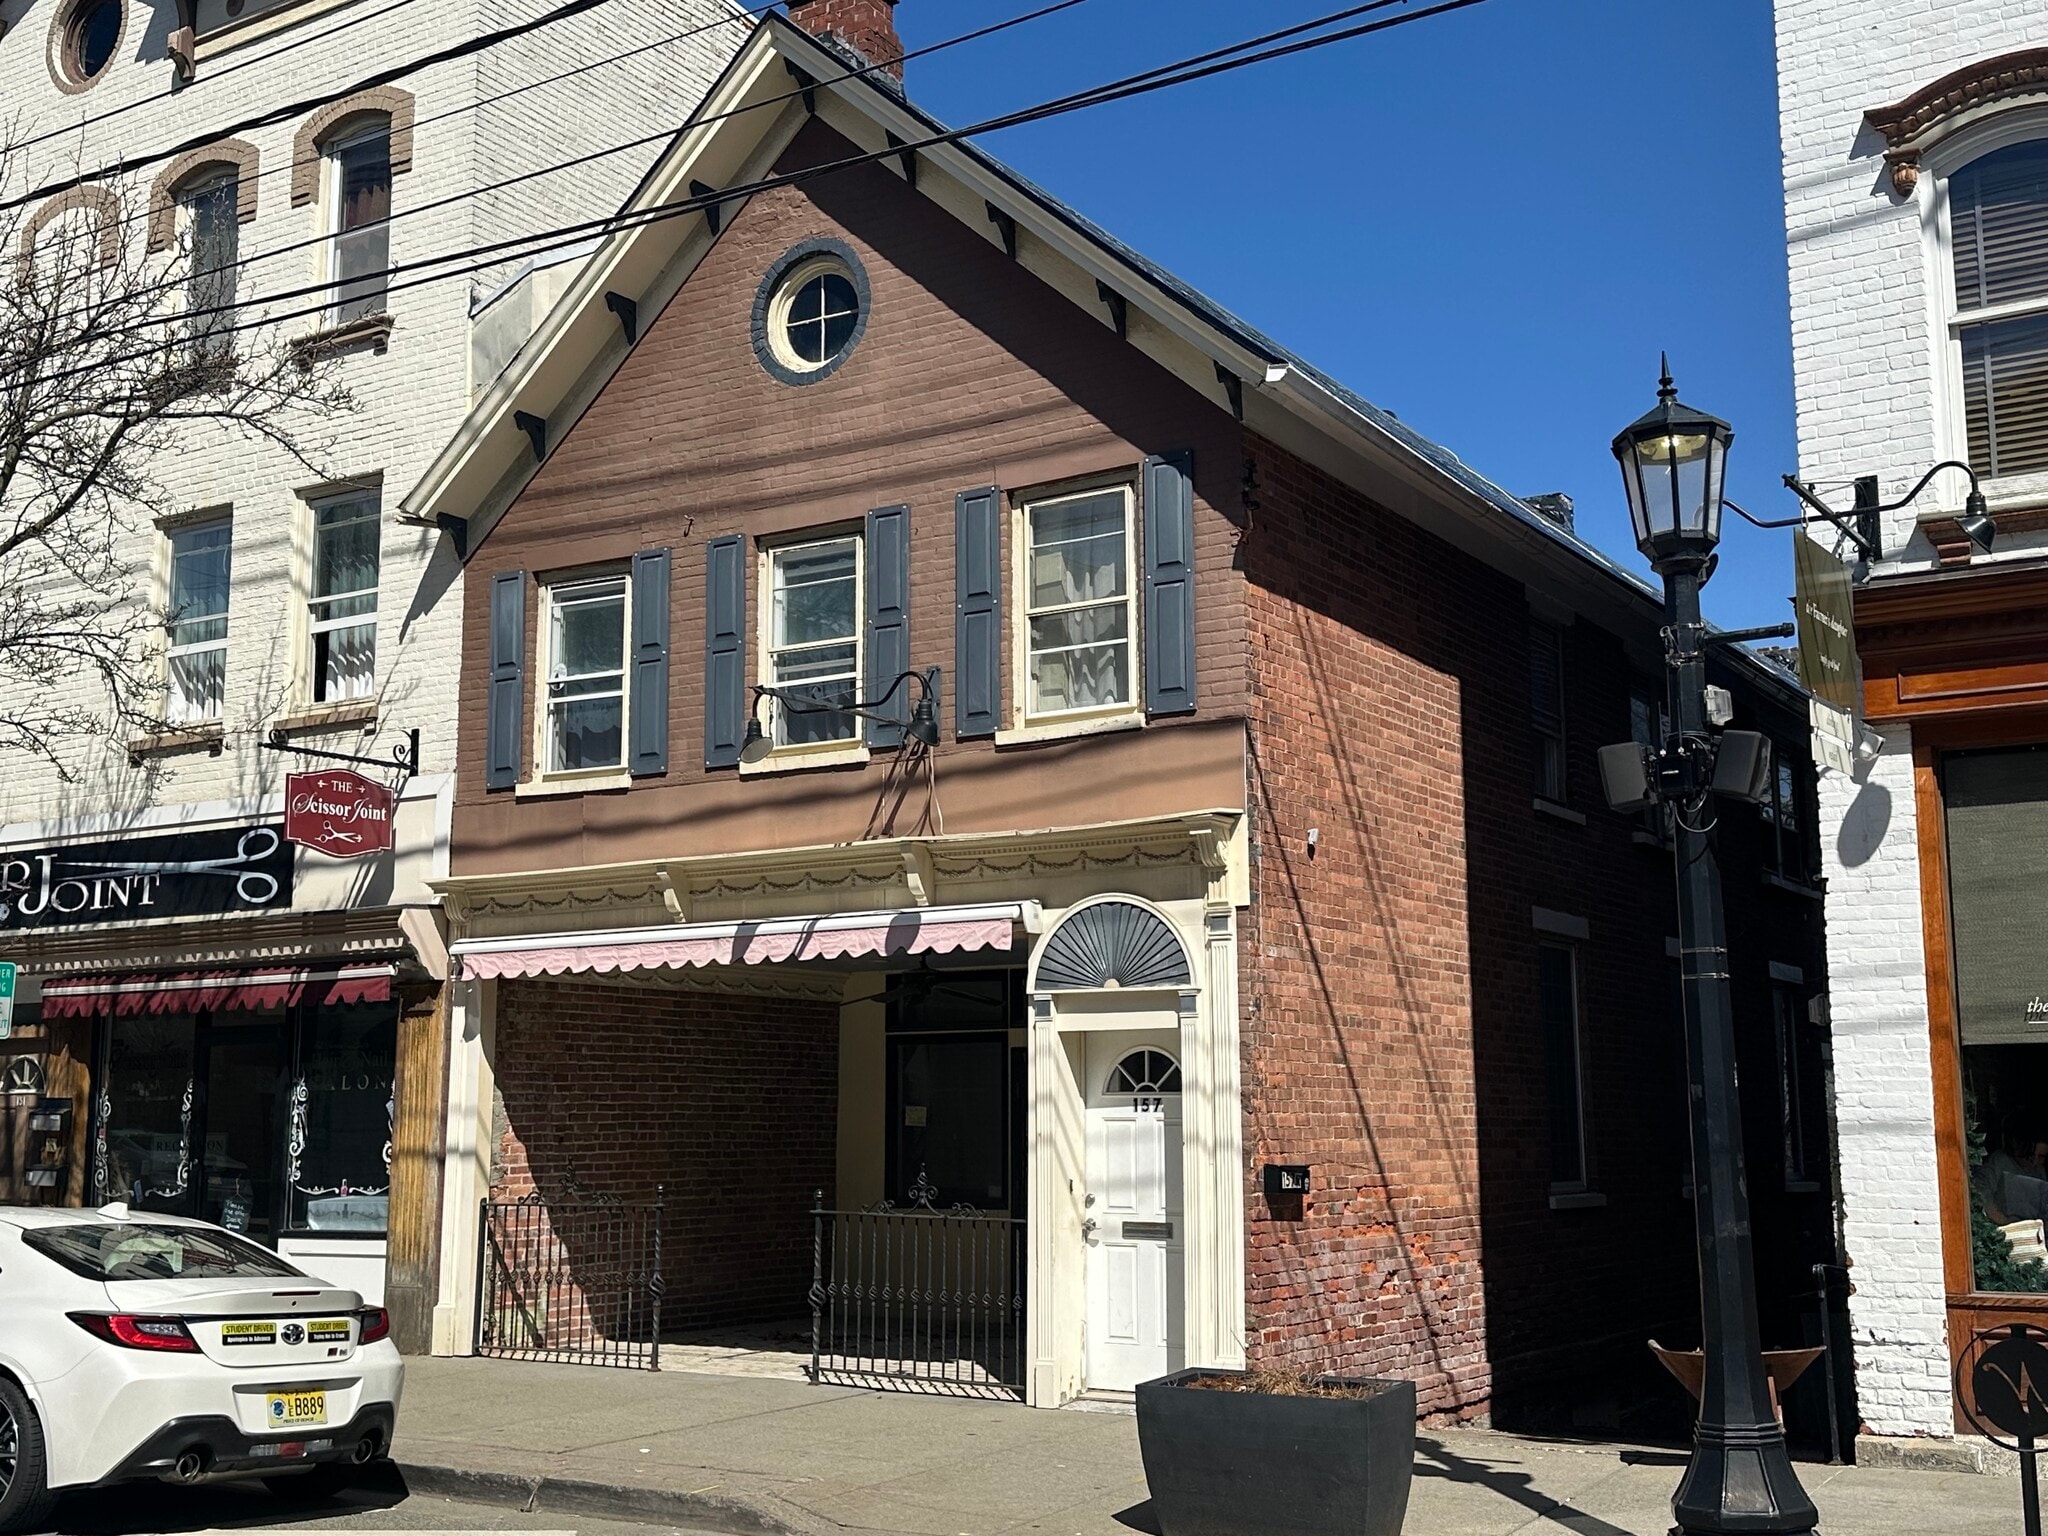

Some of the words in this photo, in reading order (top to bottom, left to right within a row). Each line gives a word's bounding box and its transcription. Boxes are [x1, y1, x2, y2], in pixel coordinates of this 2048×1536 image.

[331, 780, 353, 793] THE
[292, 792, 352, 817] Scissor
[342, 798, 387, 823] Joint
[2027, 996, 2048, 1013] the
[1133, 1097, 1162, 1113] 157
[226, 1324, 253, 1334] STUDENT
[253, 1324, 274, 1333] DRIVER
[310, 1322, 332, 1332] STUDENT
[332, 1321, 348, 1331] DRIVER
[295, 1396, 323, 1416] B889
